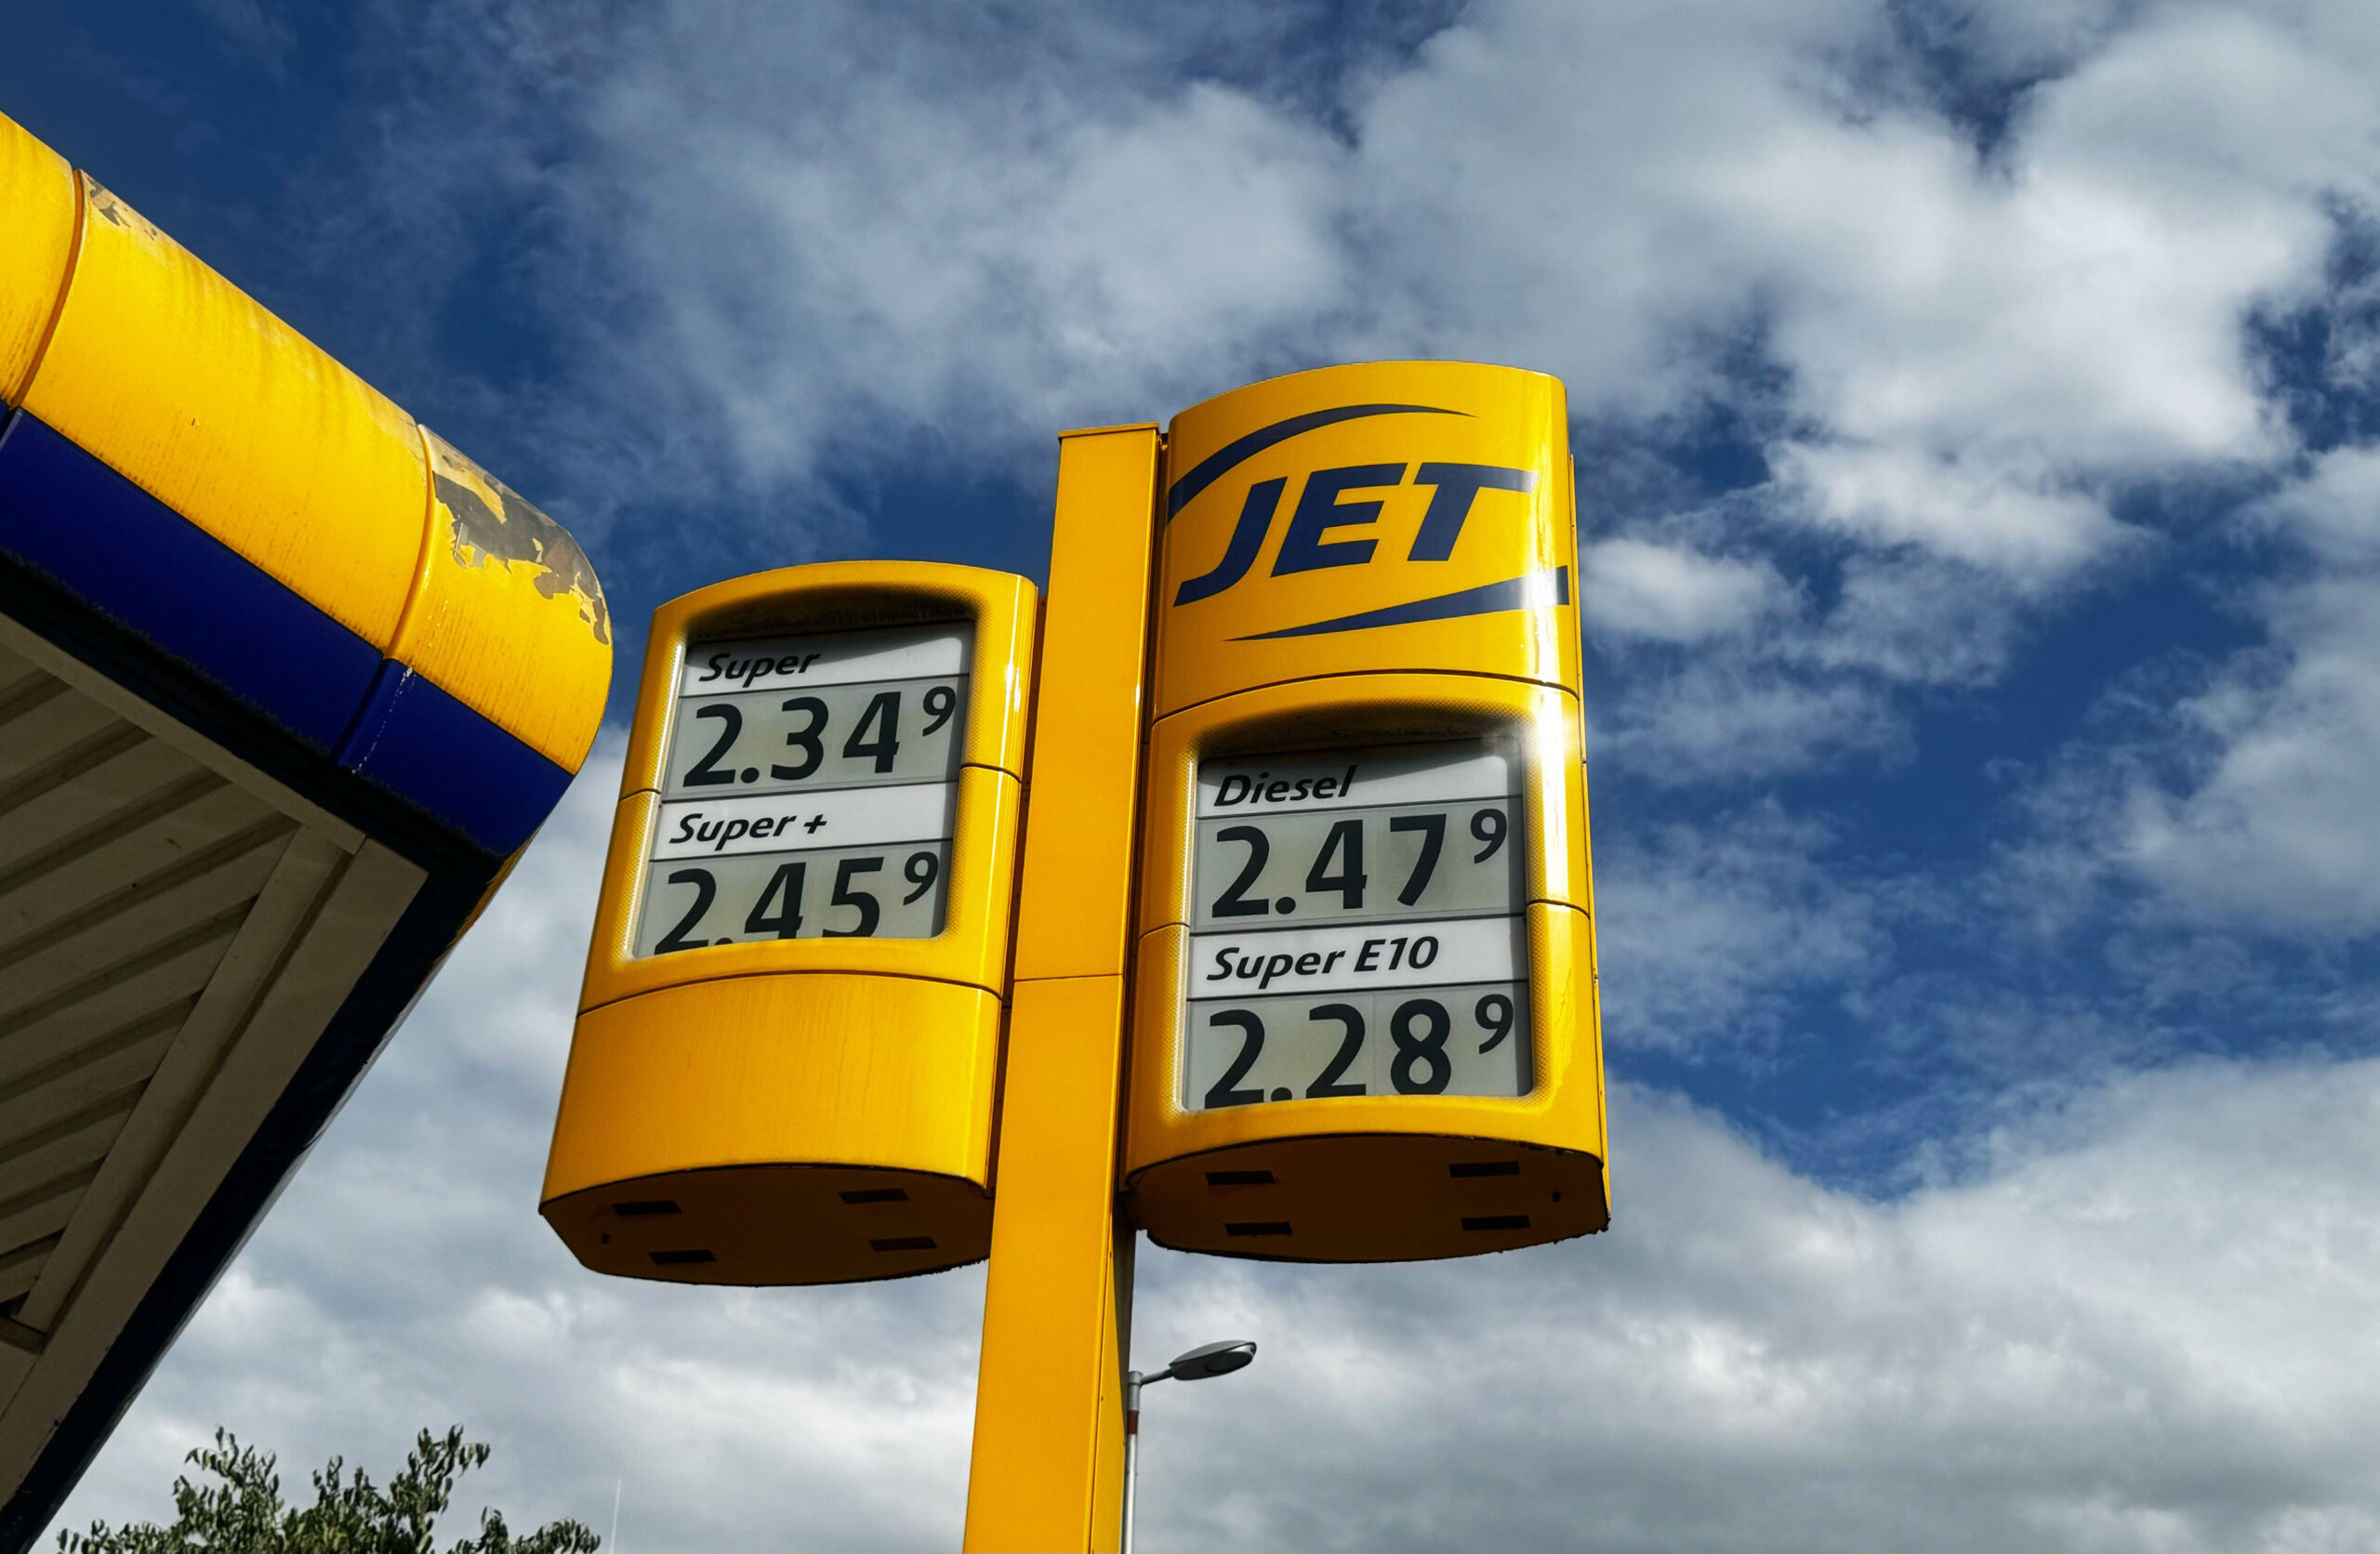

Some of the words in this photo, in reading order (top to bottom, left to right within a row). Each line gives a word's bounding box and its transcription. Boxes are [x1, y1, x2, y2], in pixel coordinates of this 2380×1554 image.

[1173, 462, 1540, 607] JET
[699, 652, 821, 688] Super
[1213, 765, 1357, 807] Diesel
[669, 813, 796, 850] Super
[1207, 947, 1345, 989] Super
[1354, 936, 1438, 971] E10
